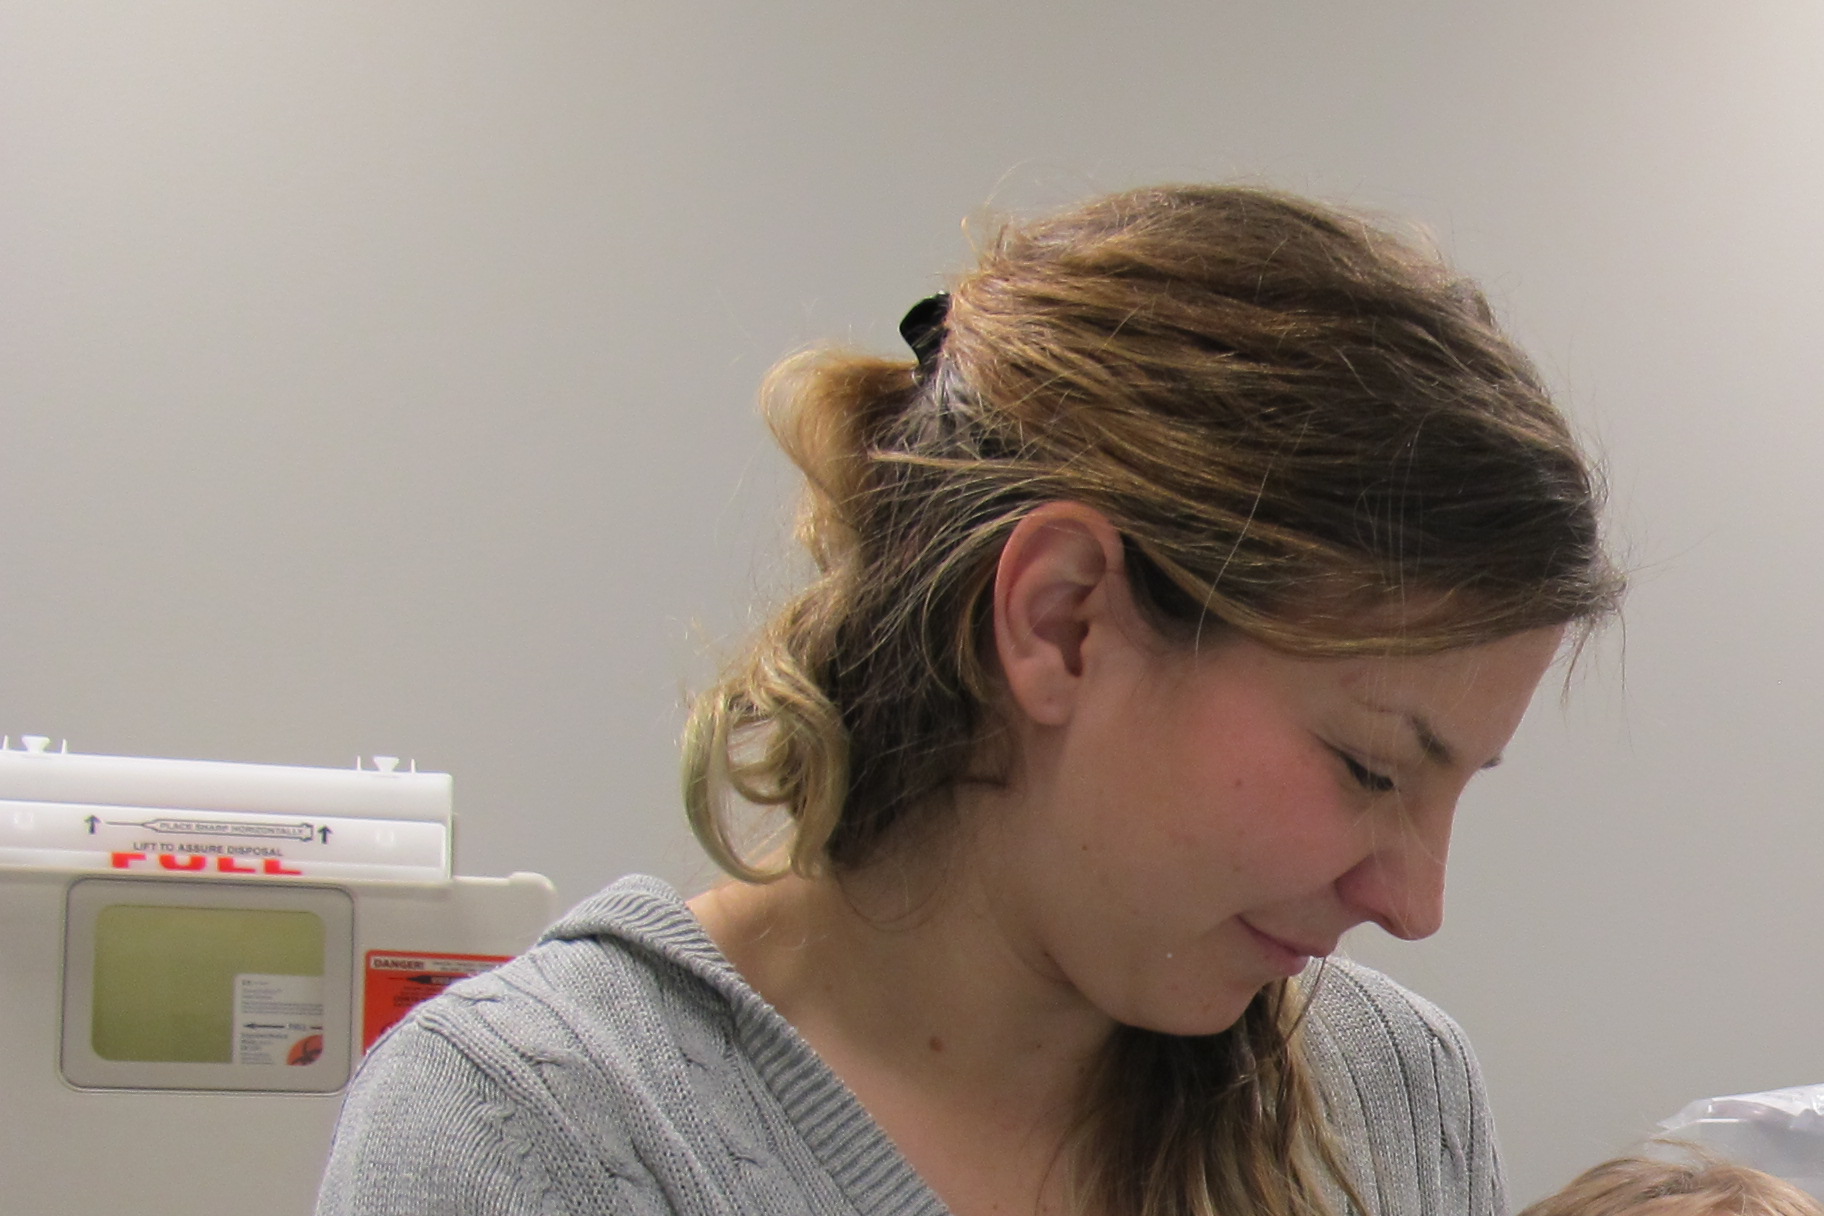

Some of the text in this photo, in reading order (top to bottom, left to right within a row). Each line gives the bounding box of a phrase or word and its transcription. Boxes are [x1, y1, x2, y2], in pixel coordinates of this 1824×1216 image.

[160, 822, 192, 830] PLACE
[133, 842, 283, 857] LIFT TO ASSURE DISPOSAL
